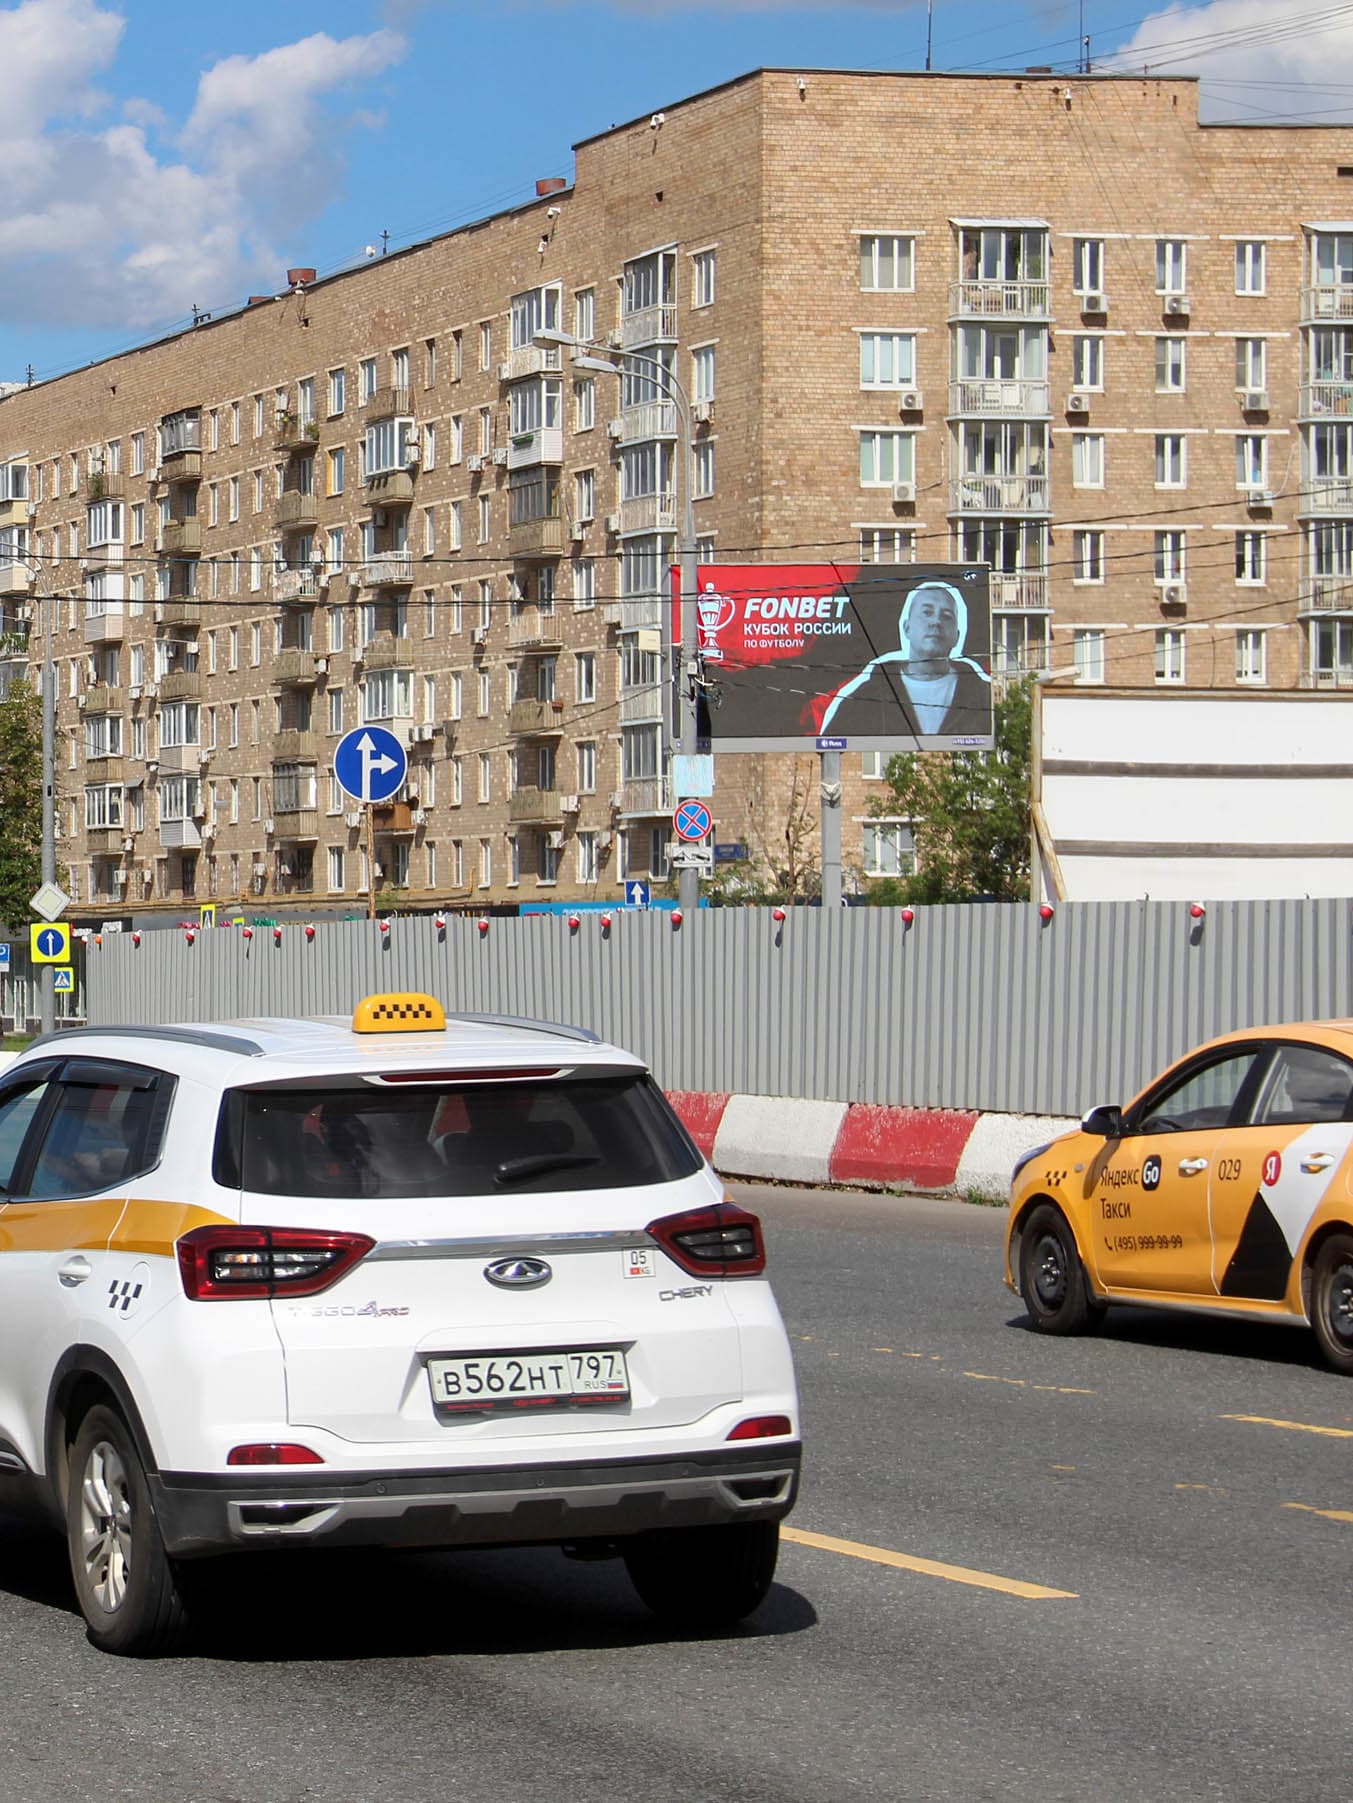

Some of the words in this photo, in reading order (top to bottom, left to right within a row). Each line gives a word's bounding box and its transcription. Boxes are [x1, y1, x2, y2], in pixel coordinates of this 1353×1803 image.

[743, 596, 851, 619] FONBET
[743, 623, 789, 636] КУБОК
[794, 622, 852, 635] РОССИИ
[744, 639, 758, 648] ПО
[759, 639, 805, 648] ФУТБОЛУ
[1100, 1166, 1140, 1189] Яндекс
[1143, 1161, 1159, 1184] Go
[1218, 1159, 1241, 1181] 029
[1265, 1156, 1277, 1180] Я
[1100, 1198, 1131, 1219] Такси
[1113, 1235, 1136, 1252] (495)
[1138, 1234, 1183, 1250] 999-99-99
[630, 1250, 647, 1265] 05
[659, 1285, 713, 1301] CHERY
[443, 1360, 565, 1395] В562НТ
[570, 1355, 615, 1379] 797
[584, 1380, 607, 1389] RUS
